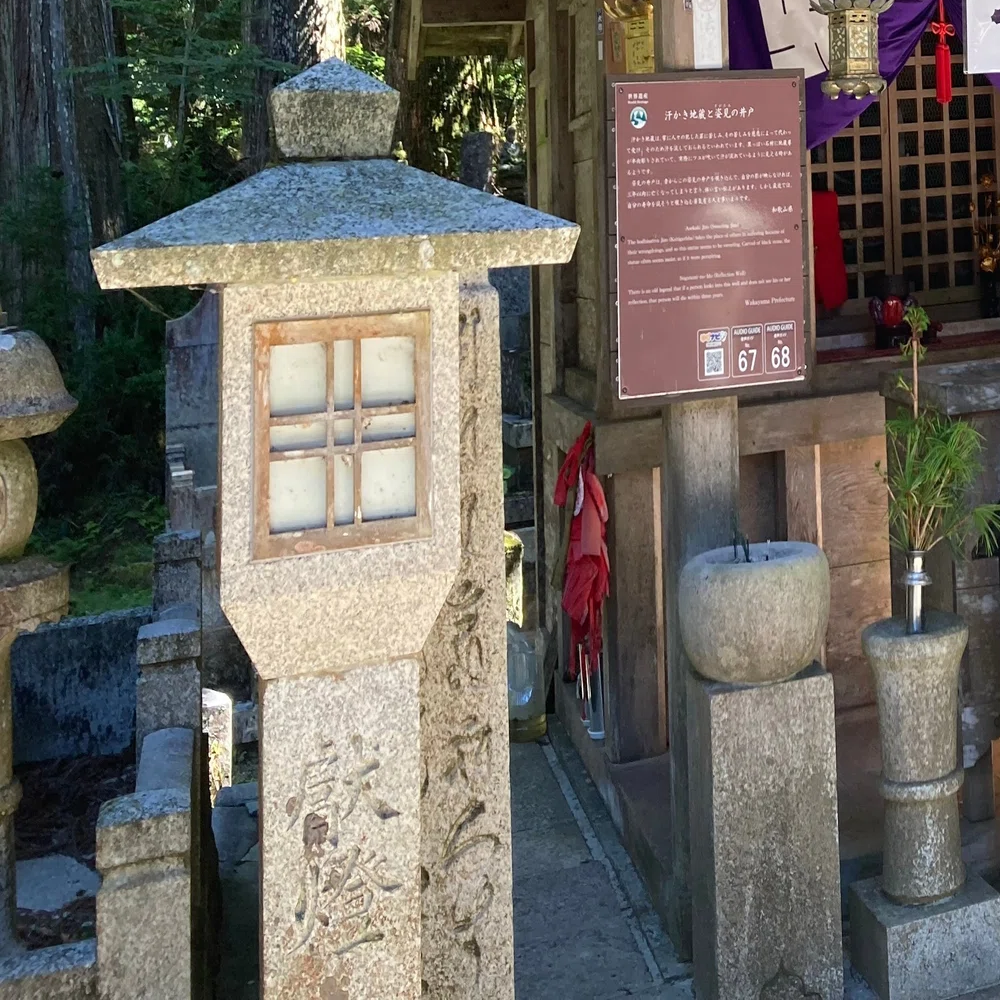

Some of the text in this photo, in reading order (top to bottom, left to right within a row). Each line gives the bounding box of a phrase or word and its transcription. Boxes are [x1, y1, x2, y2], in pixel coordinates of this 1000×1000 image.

[664, 106, 754, 121] 汗かき地蔵と姿見の井戸
[771, 296, 795, 304] Prefecture
[738, 349, 757, 372] 67
[771, 345, 790, 368] 68
